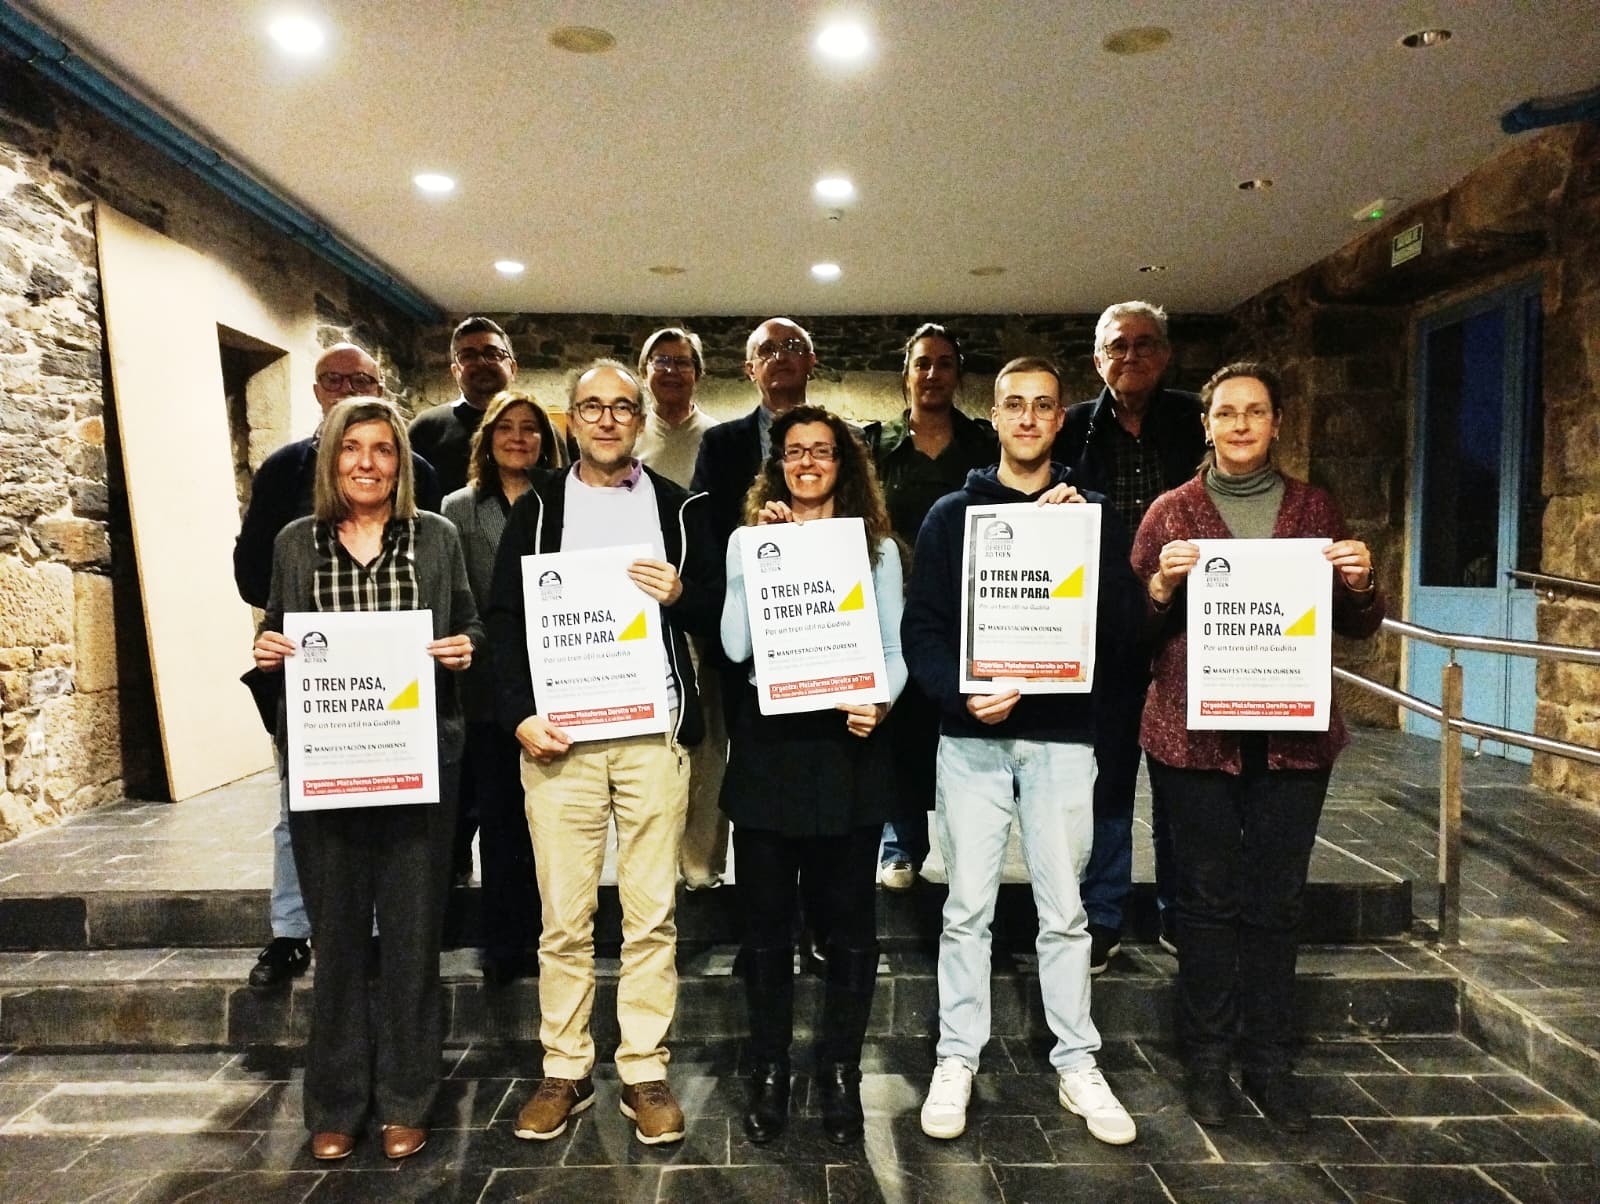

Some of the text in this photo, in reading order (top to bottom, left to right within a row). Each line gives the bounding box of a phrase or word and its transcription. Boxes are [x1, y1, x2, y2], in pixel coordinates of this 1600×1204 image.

[980, 570, 987, 581] O
[990, 570, 1018, 581] TREN
[761, 580, 835, 600] O TREN PASA,
[980, 587, 1050, 599] O TREN PARA
[764, 601, 835, 620] O TREN PARA
[1204, 602, 1284, 616] O TREN PASA,
[542, 610, 616, 628] O TREN PASA,
[1204, 623, 1281, 636] O TREN PARA
[543, 630, 615, 648] O TREN PARA
[303, 677, 386, 691] O TREN PASA,
[304, 698, 384, 713] O TREN PARA
[337, 778, 372, 786] Plataforma
